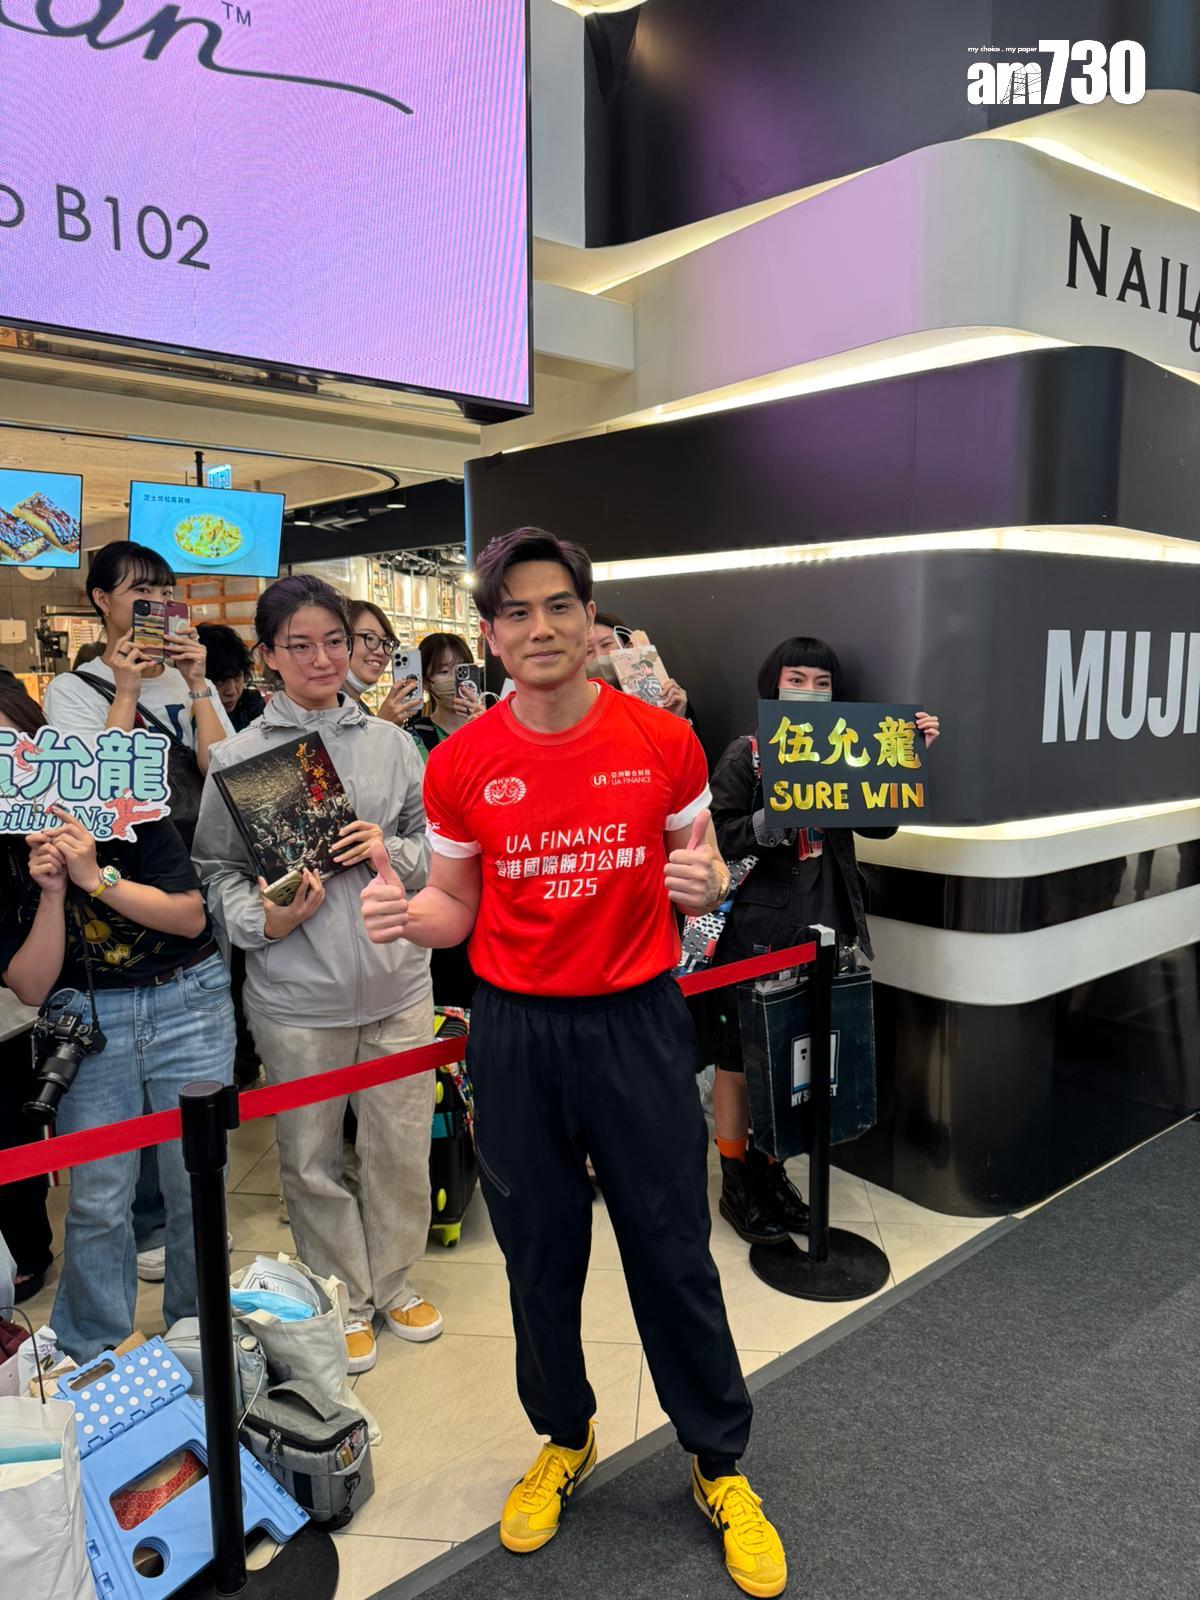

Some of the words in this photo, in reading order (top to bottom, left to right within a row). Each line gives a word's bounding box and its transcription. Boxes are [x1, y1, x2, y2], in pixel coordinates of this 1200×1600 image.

[56, 183, 210, 270] B102
[768, 716, 922, 769] 伍允龍
[769, 780, 849, 812] SURE
[861, 781, 925, 809] WIN
[73, 806, 116, 838] Ng
[506, 833, 532, 854] UA
[540, 823, 628, 850] FINANCE
[495, 845, 647, 880] 香港國際腕力公開賽
[543, 877, 599, 900] 2025
